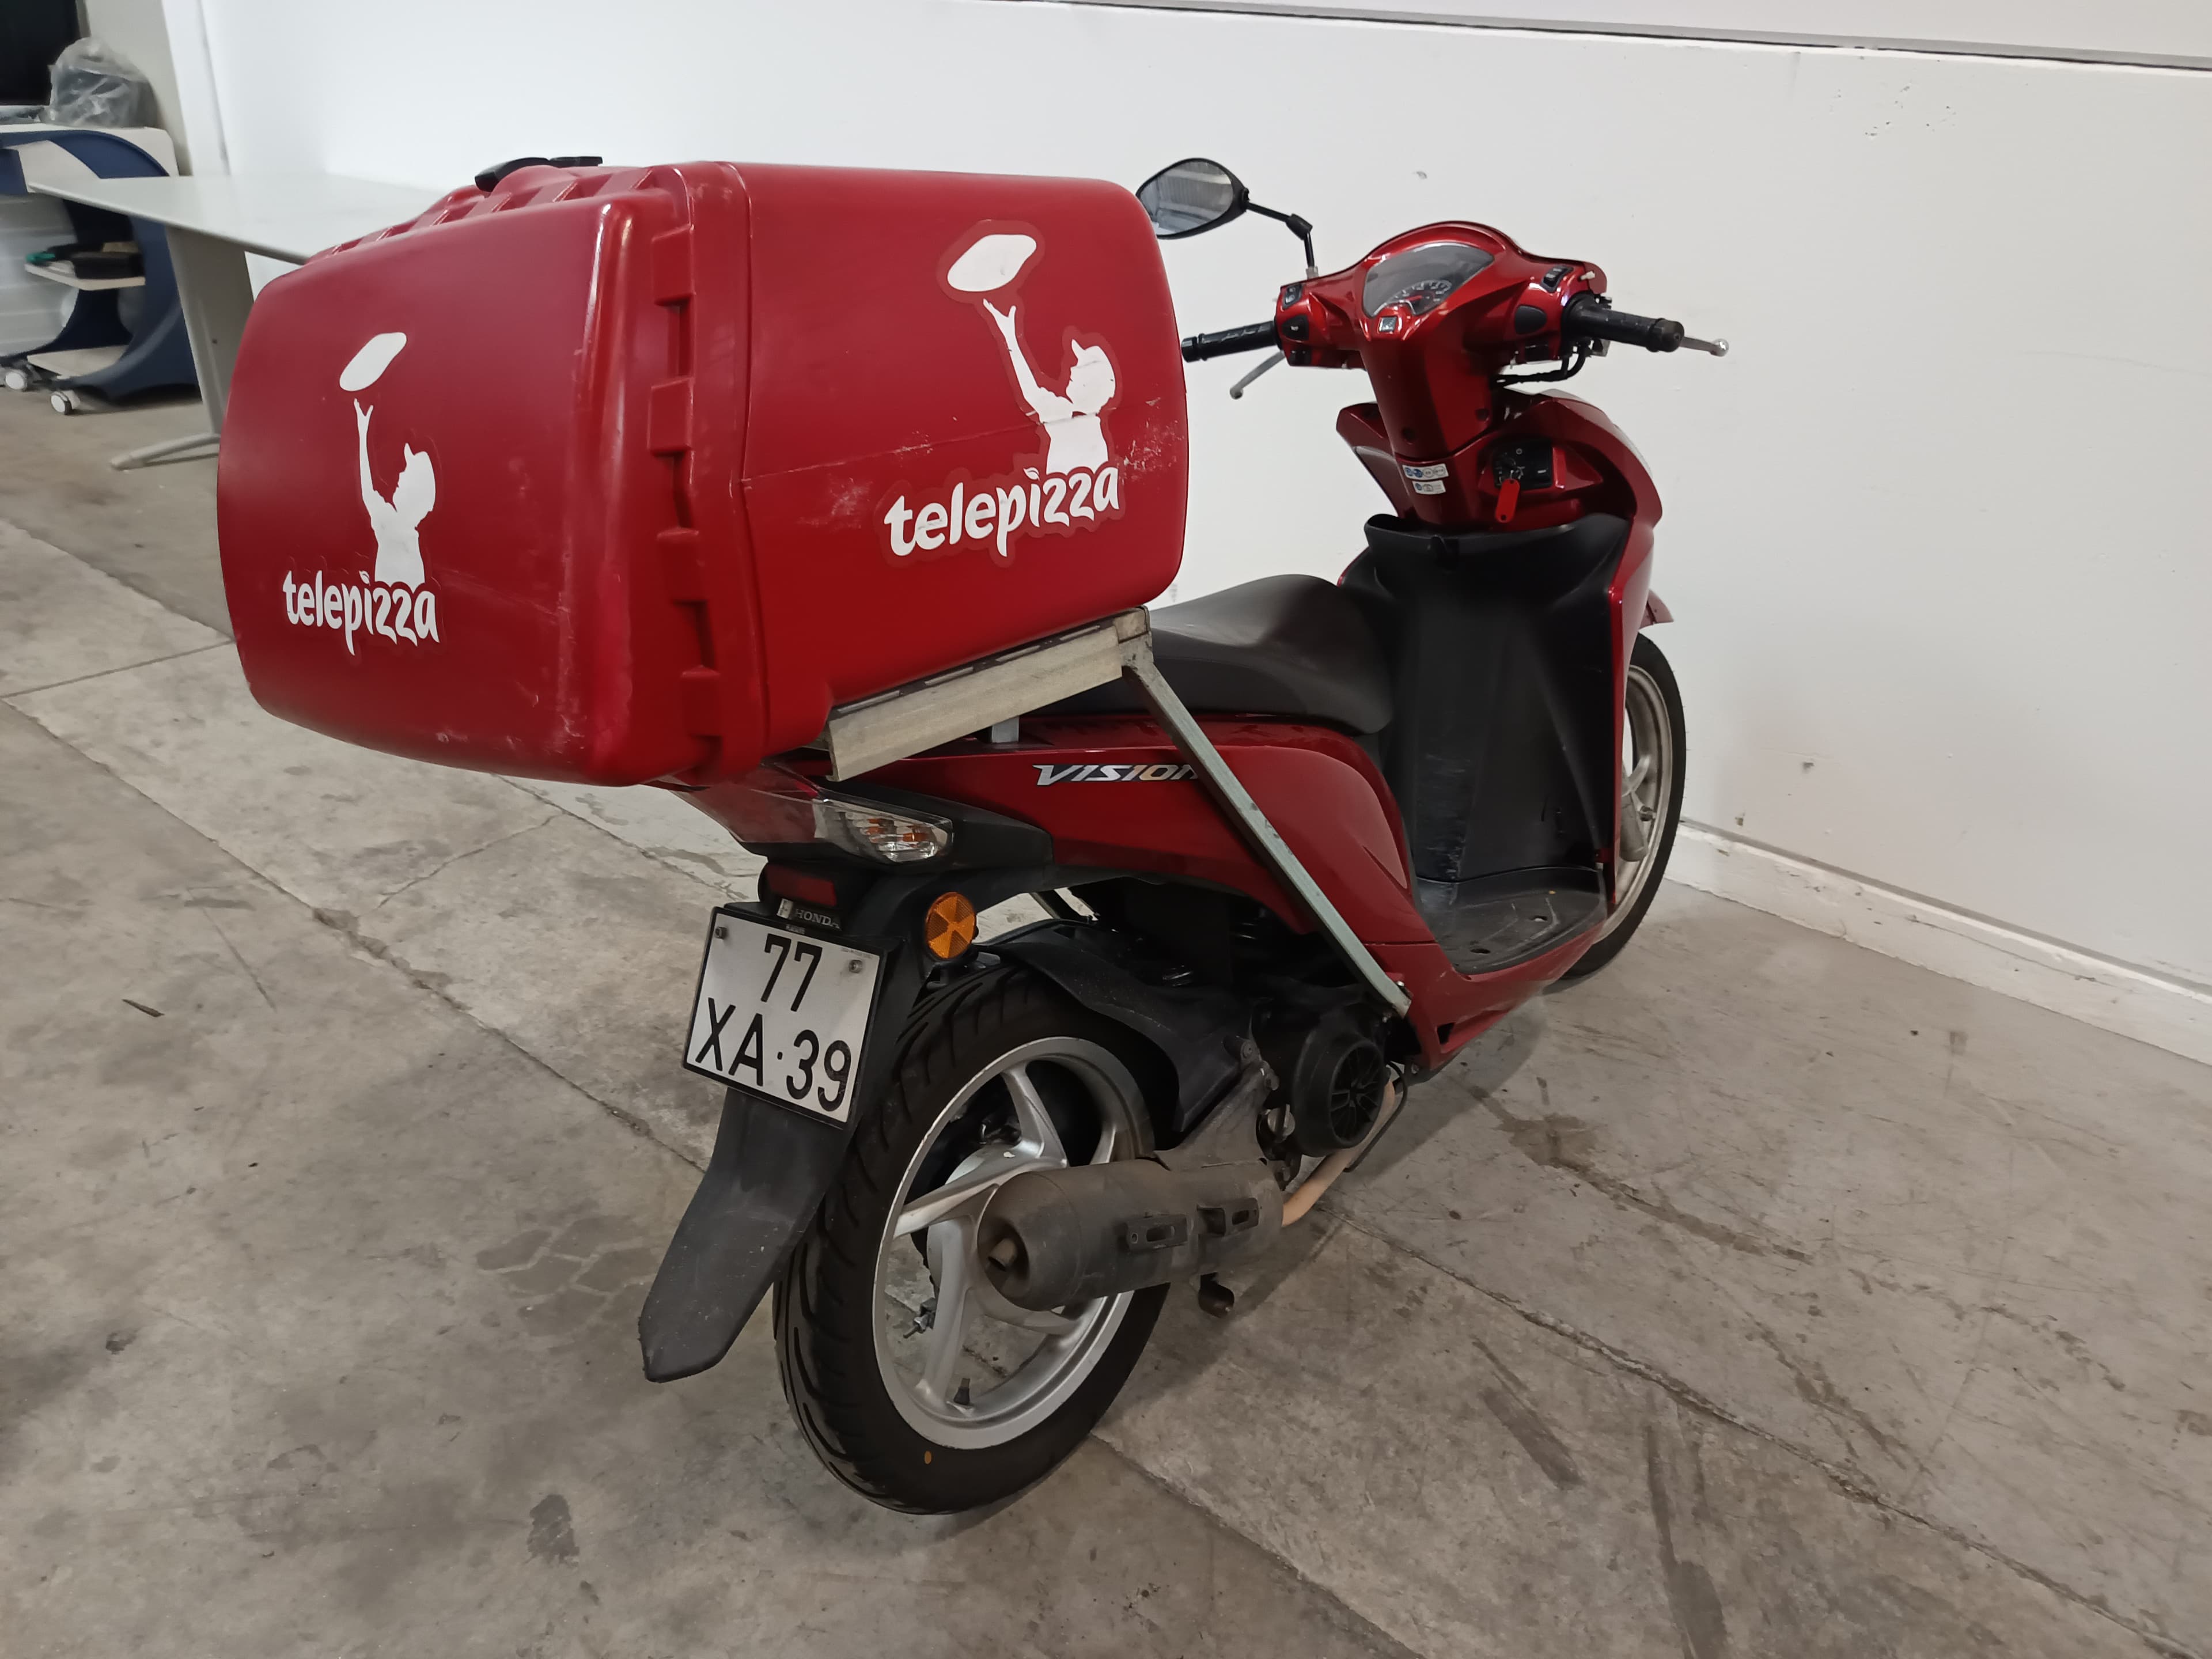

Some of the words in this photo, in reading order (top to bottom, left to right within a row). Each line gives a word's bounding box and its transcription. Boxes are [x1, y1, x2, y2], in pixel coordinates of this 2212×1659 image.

[884, 467, 1119, 556] telepizza
[282, 570, 440, 656] telepizza
[1032, 764, 1199, 786] VISION
[795, 908, 841, 930] HONDA
[760, 933, 823, 1012] 77
